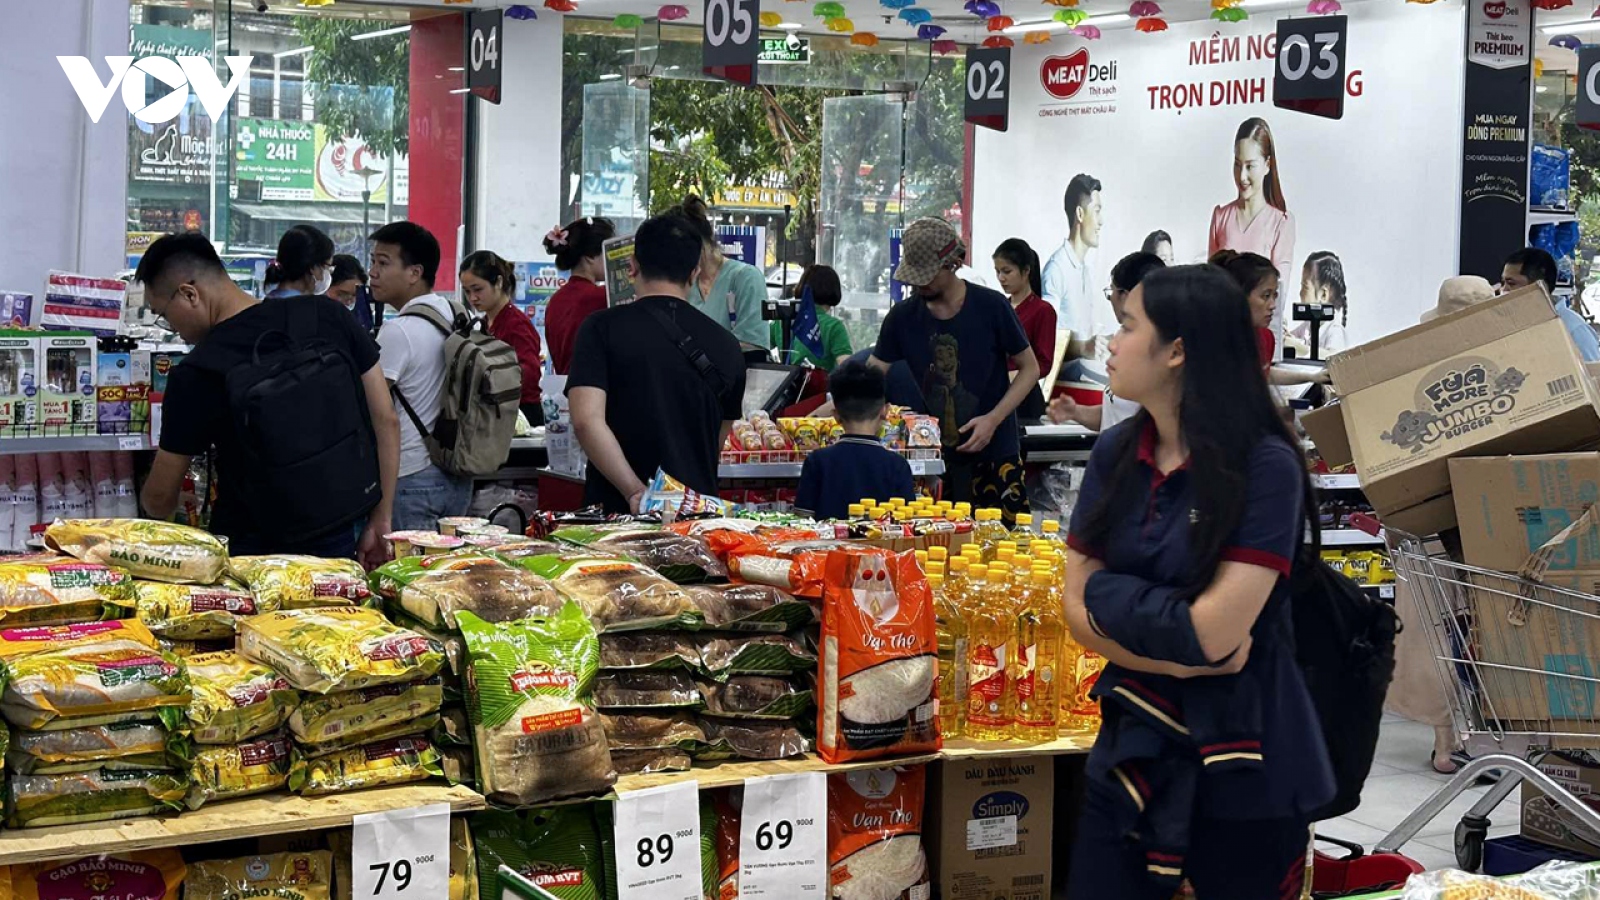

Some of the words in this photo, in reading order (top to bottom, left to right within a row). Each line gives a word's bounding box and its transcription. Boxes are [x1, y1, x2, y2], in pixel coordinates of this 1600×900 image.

[706, 0, 752, 46] 05
[471, 26, 498, 71] 04
[1189, 30, 1240, 66] MỀM
[1279, 32, 1340, 81] 03
[1474, 41, 1524, 56] PREMIUM
[967, 60, 1005, 100] 02
[1048, 65, 1085, 85] MEAT
[1089, 60, 1117, 82] Deli
[1147, 82, 1204, 115] TRỌN
[1209, 78, 1265, 106] DINH
[1468, 124, 1489, 140] DÒNG
[1489, 127, 1525, 141] PREMIUM
[1475, 114, 1495, 125] MUA
[1495, 115, 1517, 125] NGAY
[266, 143, 297, 160] 24H
[1433, 384, 1489, 412] MORE
[1420, 394, 1516, 443] JUMBO
[1444, 415, 1494, 440] BURGER
[109, 547, 139, 562] BẢO
[143, 556, 182, 570] MINH
[977, 796, 1024, 817] Simply
[755, 820, 793, 851] 69
[637, 833, 674, 867] 89
[49, 865, 76, 880] GẠO
[79, 859, 105, 872] BẢO
[108, 862, 146, 875] MINH
[369, 859, 412, 895] 79
[555, 872, 580, 882] RVT
